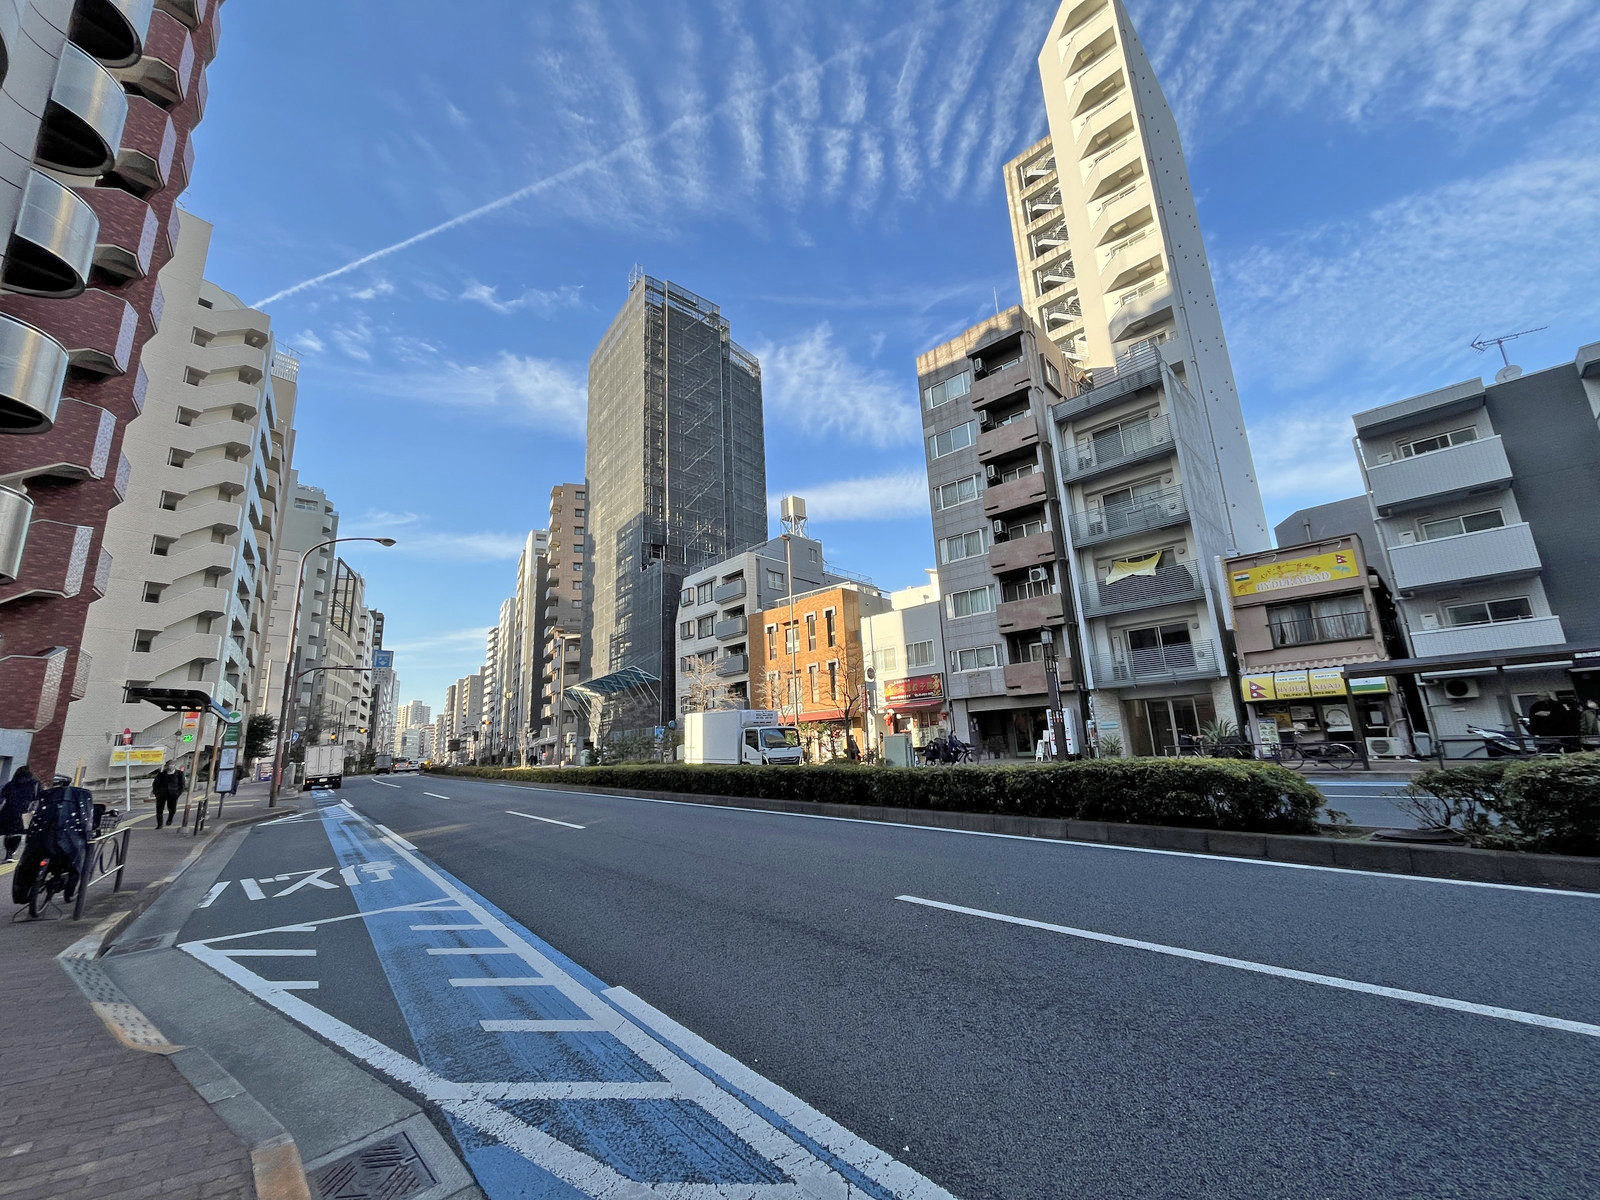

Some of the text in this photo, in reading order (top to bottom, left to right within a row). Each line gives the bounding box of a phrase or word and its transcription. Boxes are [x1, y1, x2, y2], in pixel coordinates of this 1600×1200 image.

[1256, 571, 1330, 591] HYDERABAD
[197, 860, 397, 908] バス停
